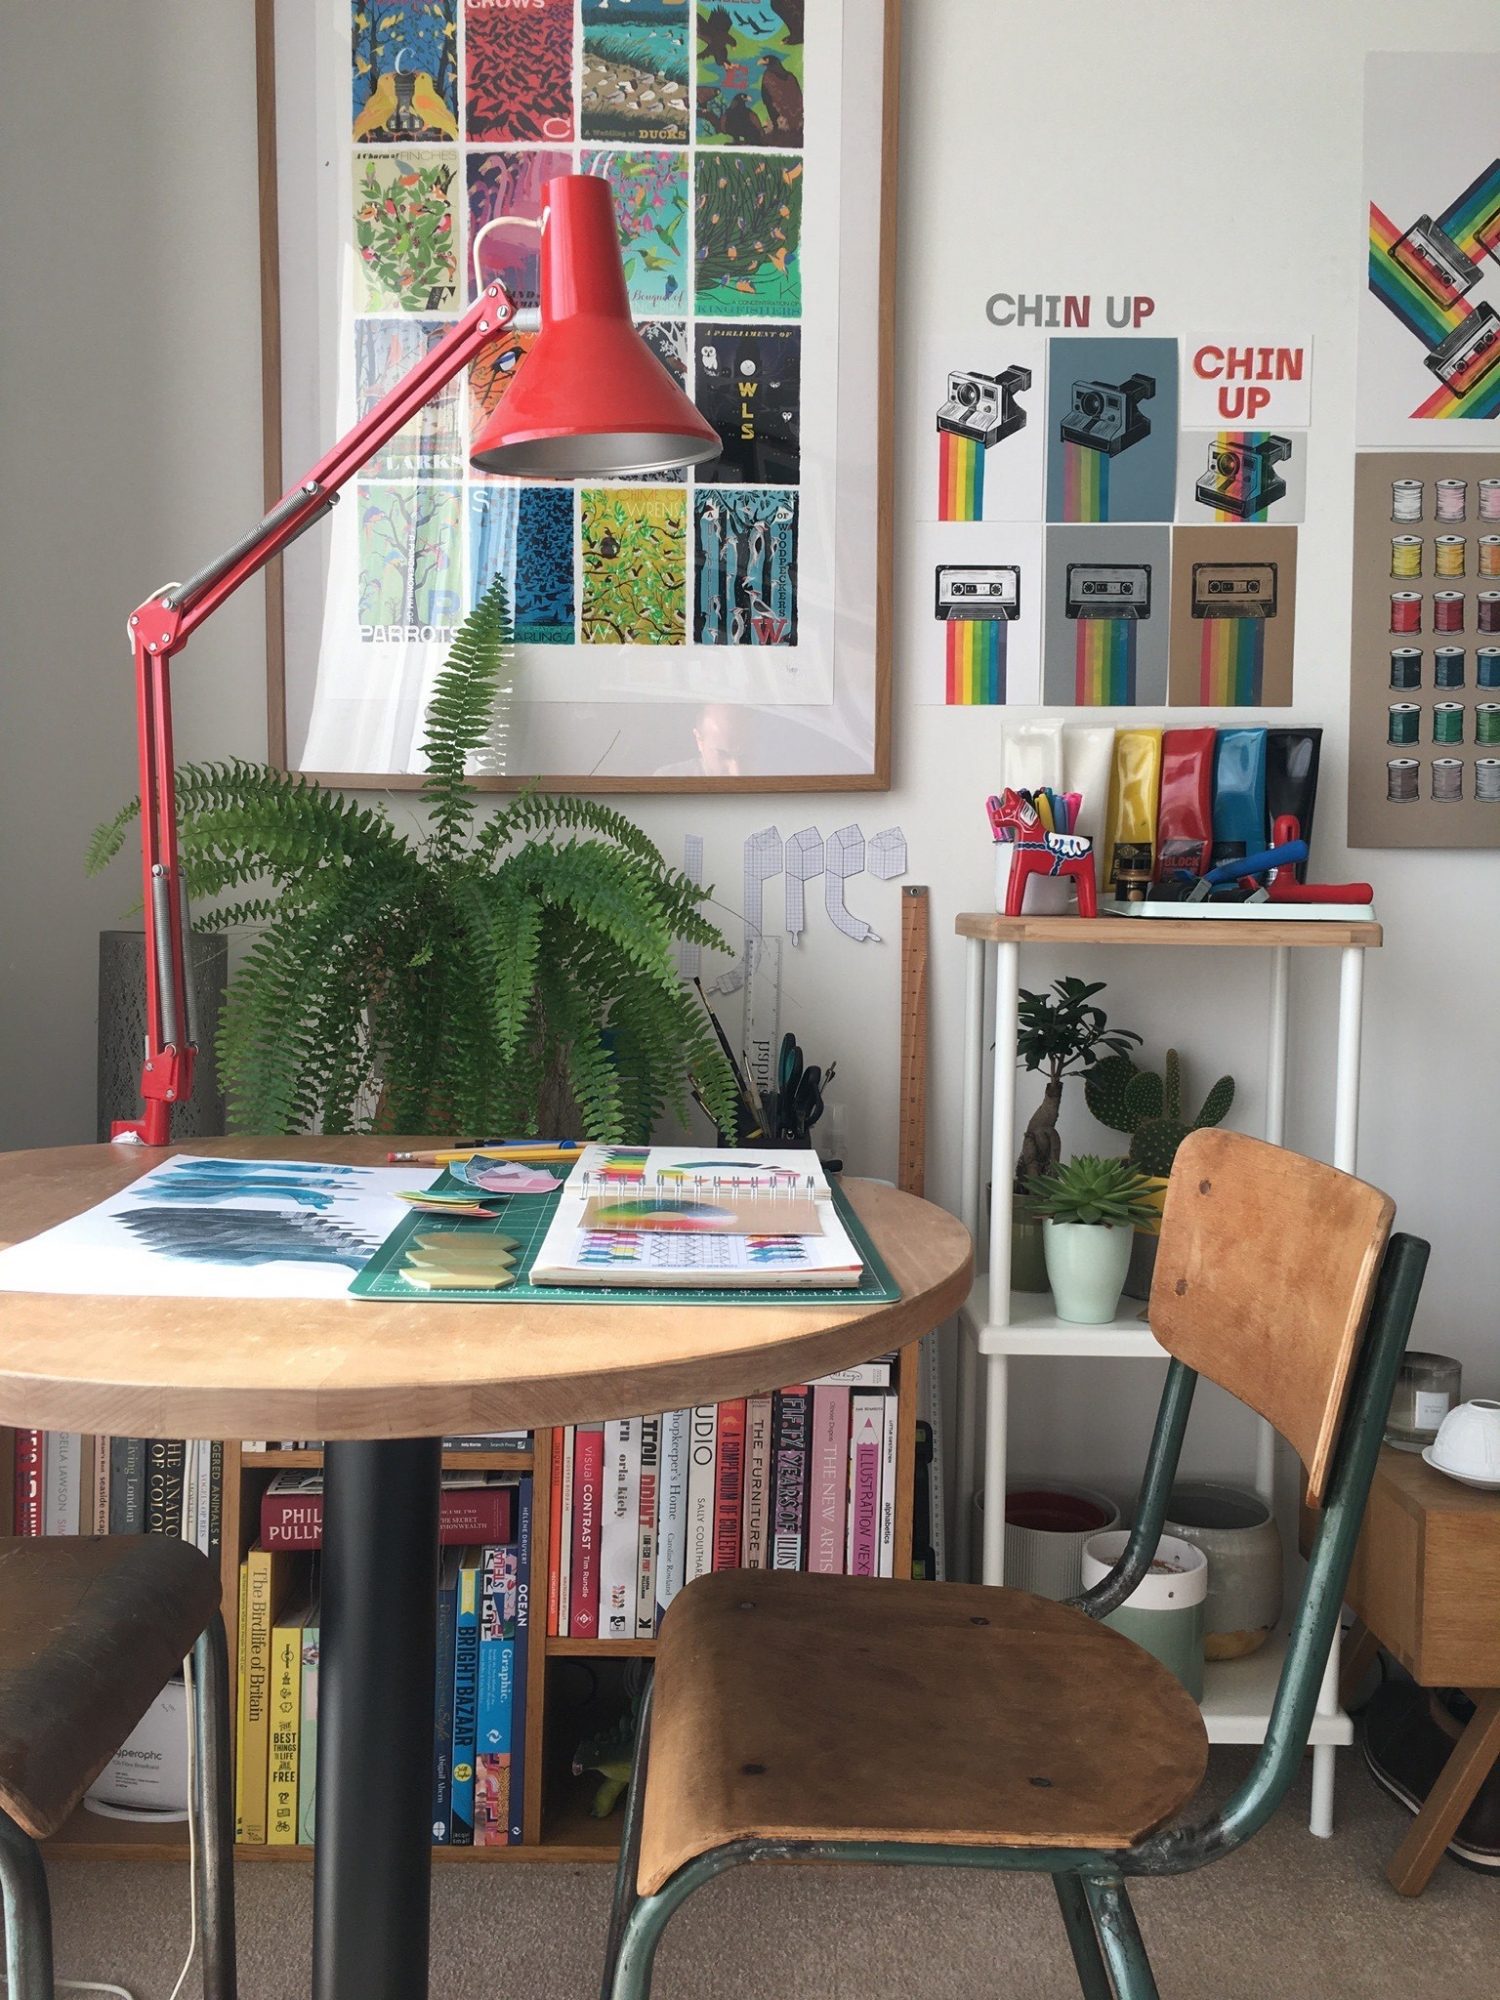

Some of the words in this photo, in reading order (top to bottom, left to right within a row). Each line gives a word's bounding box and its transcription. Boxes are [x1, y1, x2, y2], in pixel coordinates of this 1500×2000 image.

[639, 130, 687, 140] DUCKS
[697, 304, 801, 316] KINGFISHERS
[985, 293, 1090, 327] CHIN
[1106, 296, 1155, 328] UP
[1193, 345, 1304, 380] CHIN
[1217, 386, 1270, 419] UP
[385, 454, 464, 471] LARKS
[777, 523, 789, 618] WOODPECKERS
[753, 1419, 764, 1450] THE
[781, 1397, 805, 1449] FIFTY
[58, 1432, 70, 1462] GELLA
[123, 1438, 138, 1475] Living
[151, 1443, 165, 1469] OF
[166, 1443, 182, 1468] HE
[583, 1446, 594, 1482] visual
[823, 1444, 838, 1479] THE
[617, 1454, 628, 1481] orla
[719, 1441, 740, 1500] COMPENDIUM
[778, 1455, 801, 1508] YEARS
[57, 1465, 69, 1512] LAWSON
[98, 1476, 108, 1505] seaside
[126, 1478, 138, 1523] London
[615, 1486, 628, 1519] kiely
[668, 1484, 681, 1520] Home
[750, 1457, 763, 1552] FURNITURE
[822, 1482, 836, 1522] NEW
[859, 1450, 875, 1537] ILLUSTRATION
[98, 1510, 106, 1535] escap
[164, 1474, 181, 1538] ANATO
[211, 1485, 220, 1534] ANIMALS
[282, 1508, 323, 1524] PHIL
[582, 1484, 593, 1550] CONTRAST
[696, 1497, 706, 1524] SALLY
[719, 1504, 738, 1517] OF
[777, 1511, 798, 1534] OF
[883, 1502, 893, 1545] alphabetics
[666, 1533, 675, 1562] Caroline
[820, 1526, 835, 1573] ARTIS
[252, 1567, 268, 1598] The
[581, 1571, 590, 1598] Rundle
[665, 1564, 674, 1596] Rowland
[518, 1584, 528, 1627] OCEAN
[250, 1601, 267, 1654] Birdlife
[250, 1656, 265, 1672] of
[457, 1626, 477, 1681] BRIGHT
[499, 1648, 513, 1704] Graphic.
[249, 1673, 265, 1722] Britain
[454, 1683, 475, 1748] BAZAAR
[273, 1732, 297, 1743] BEST
[273, 1744, 296, 1752] THINGS
[279, 1752, 293, 1760] LIFE
[437, 1753, 447, 1780] Abigail
[273, 1771, 296, 1783] FREE
